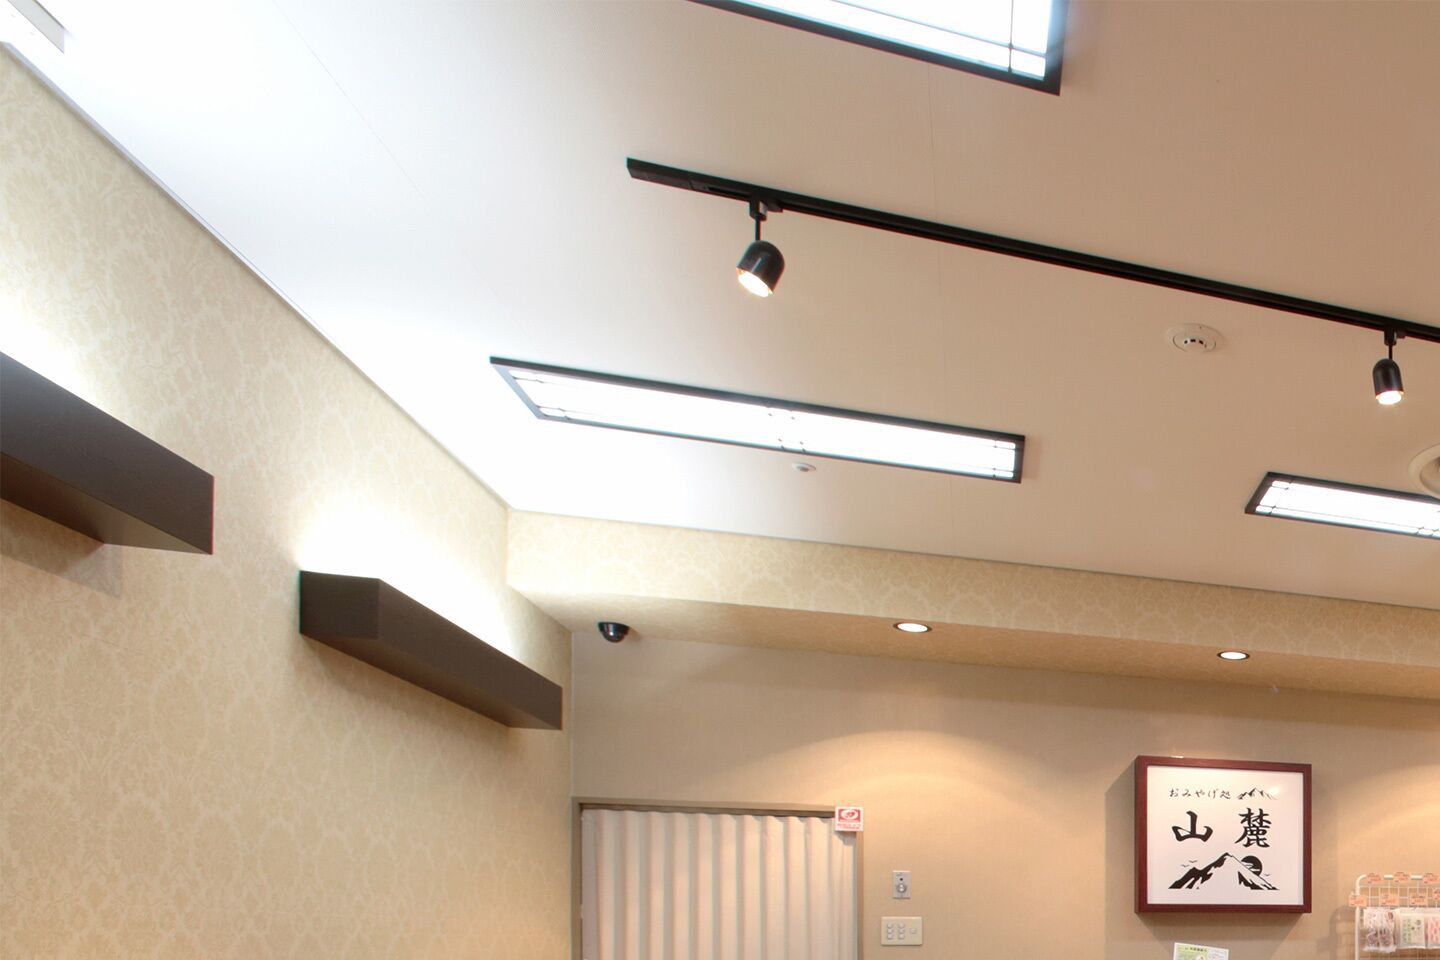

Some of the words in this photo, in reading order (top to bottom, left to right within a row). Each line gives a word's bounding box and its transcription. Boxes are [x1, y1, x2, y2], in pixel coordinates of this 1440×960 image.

[1169, 788, 1232, 800] おみやげ処
[1171, 807, 1273, 848] 山麓
